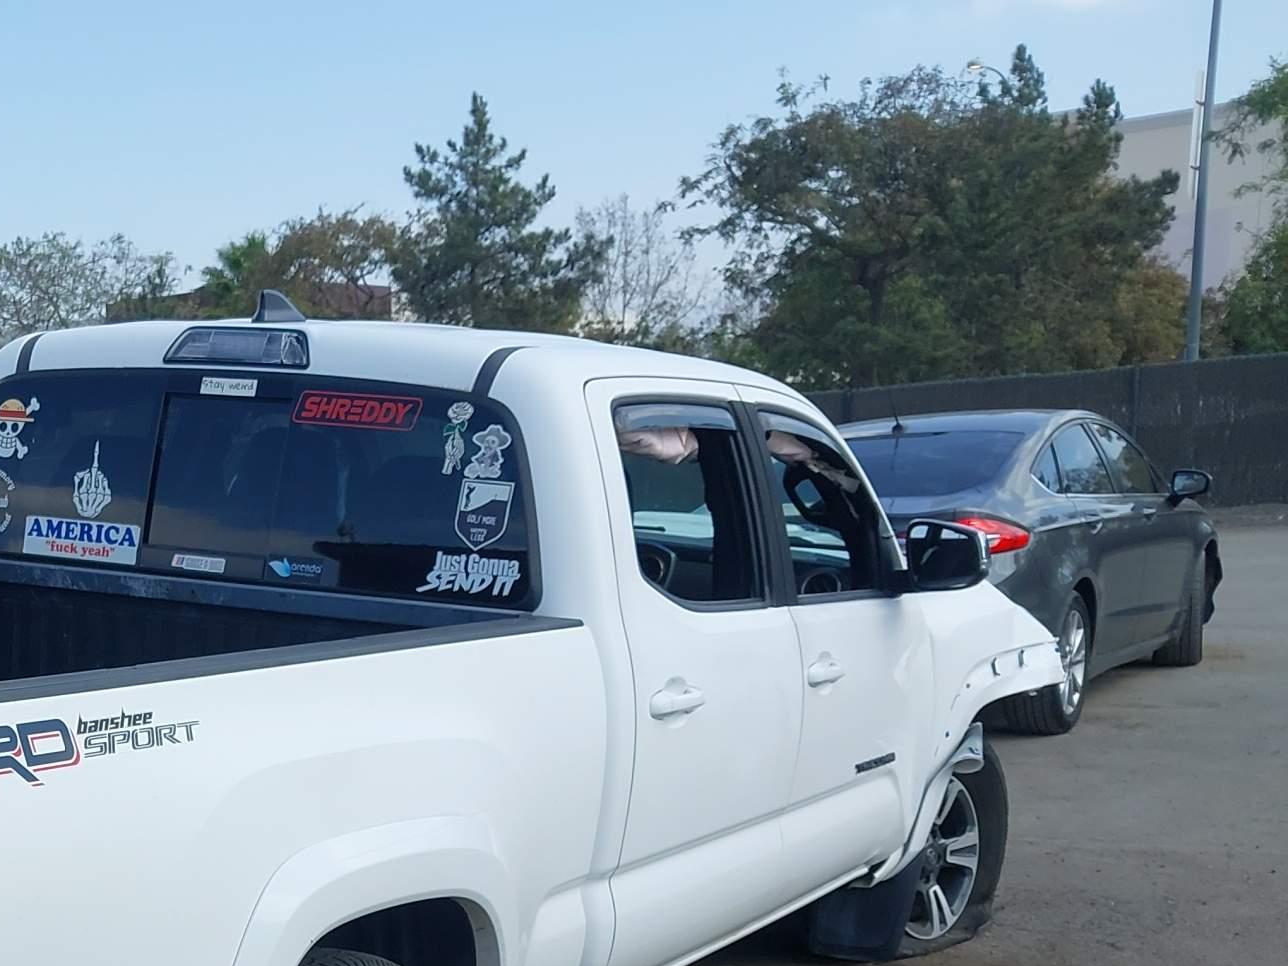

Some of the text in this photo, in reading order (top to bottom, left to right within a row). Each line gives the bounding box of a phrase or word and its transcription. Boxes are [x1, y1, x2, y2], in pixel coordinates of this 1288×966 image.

[228, 382, 254, 391] weird
[301, 396, 413, 424] SHREDDY
[27, 518, 137, 548] AMERICA
[433, 551, 520, 576] Just Gonna
[415, 570, 521, 597] SEND IT
[76, 706, 153, 735] banshee
[83, 720, 200, 759] SPORT
